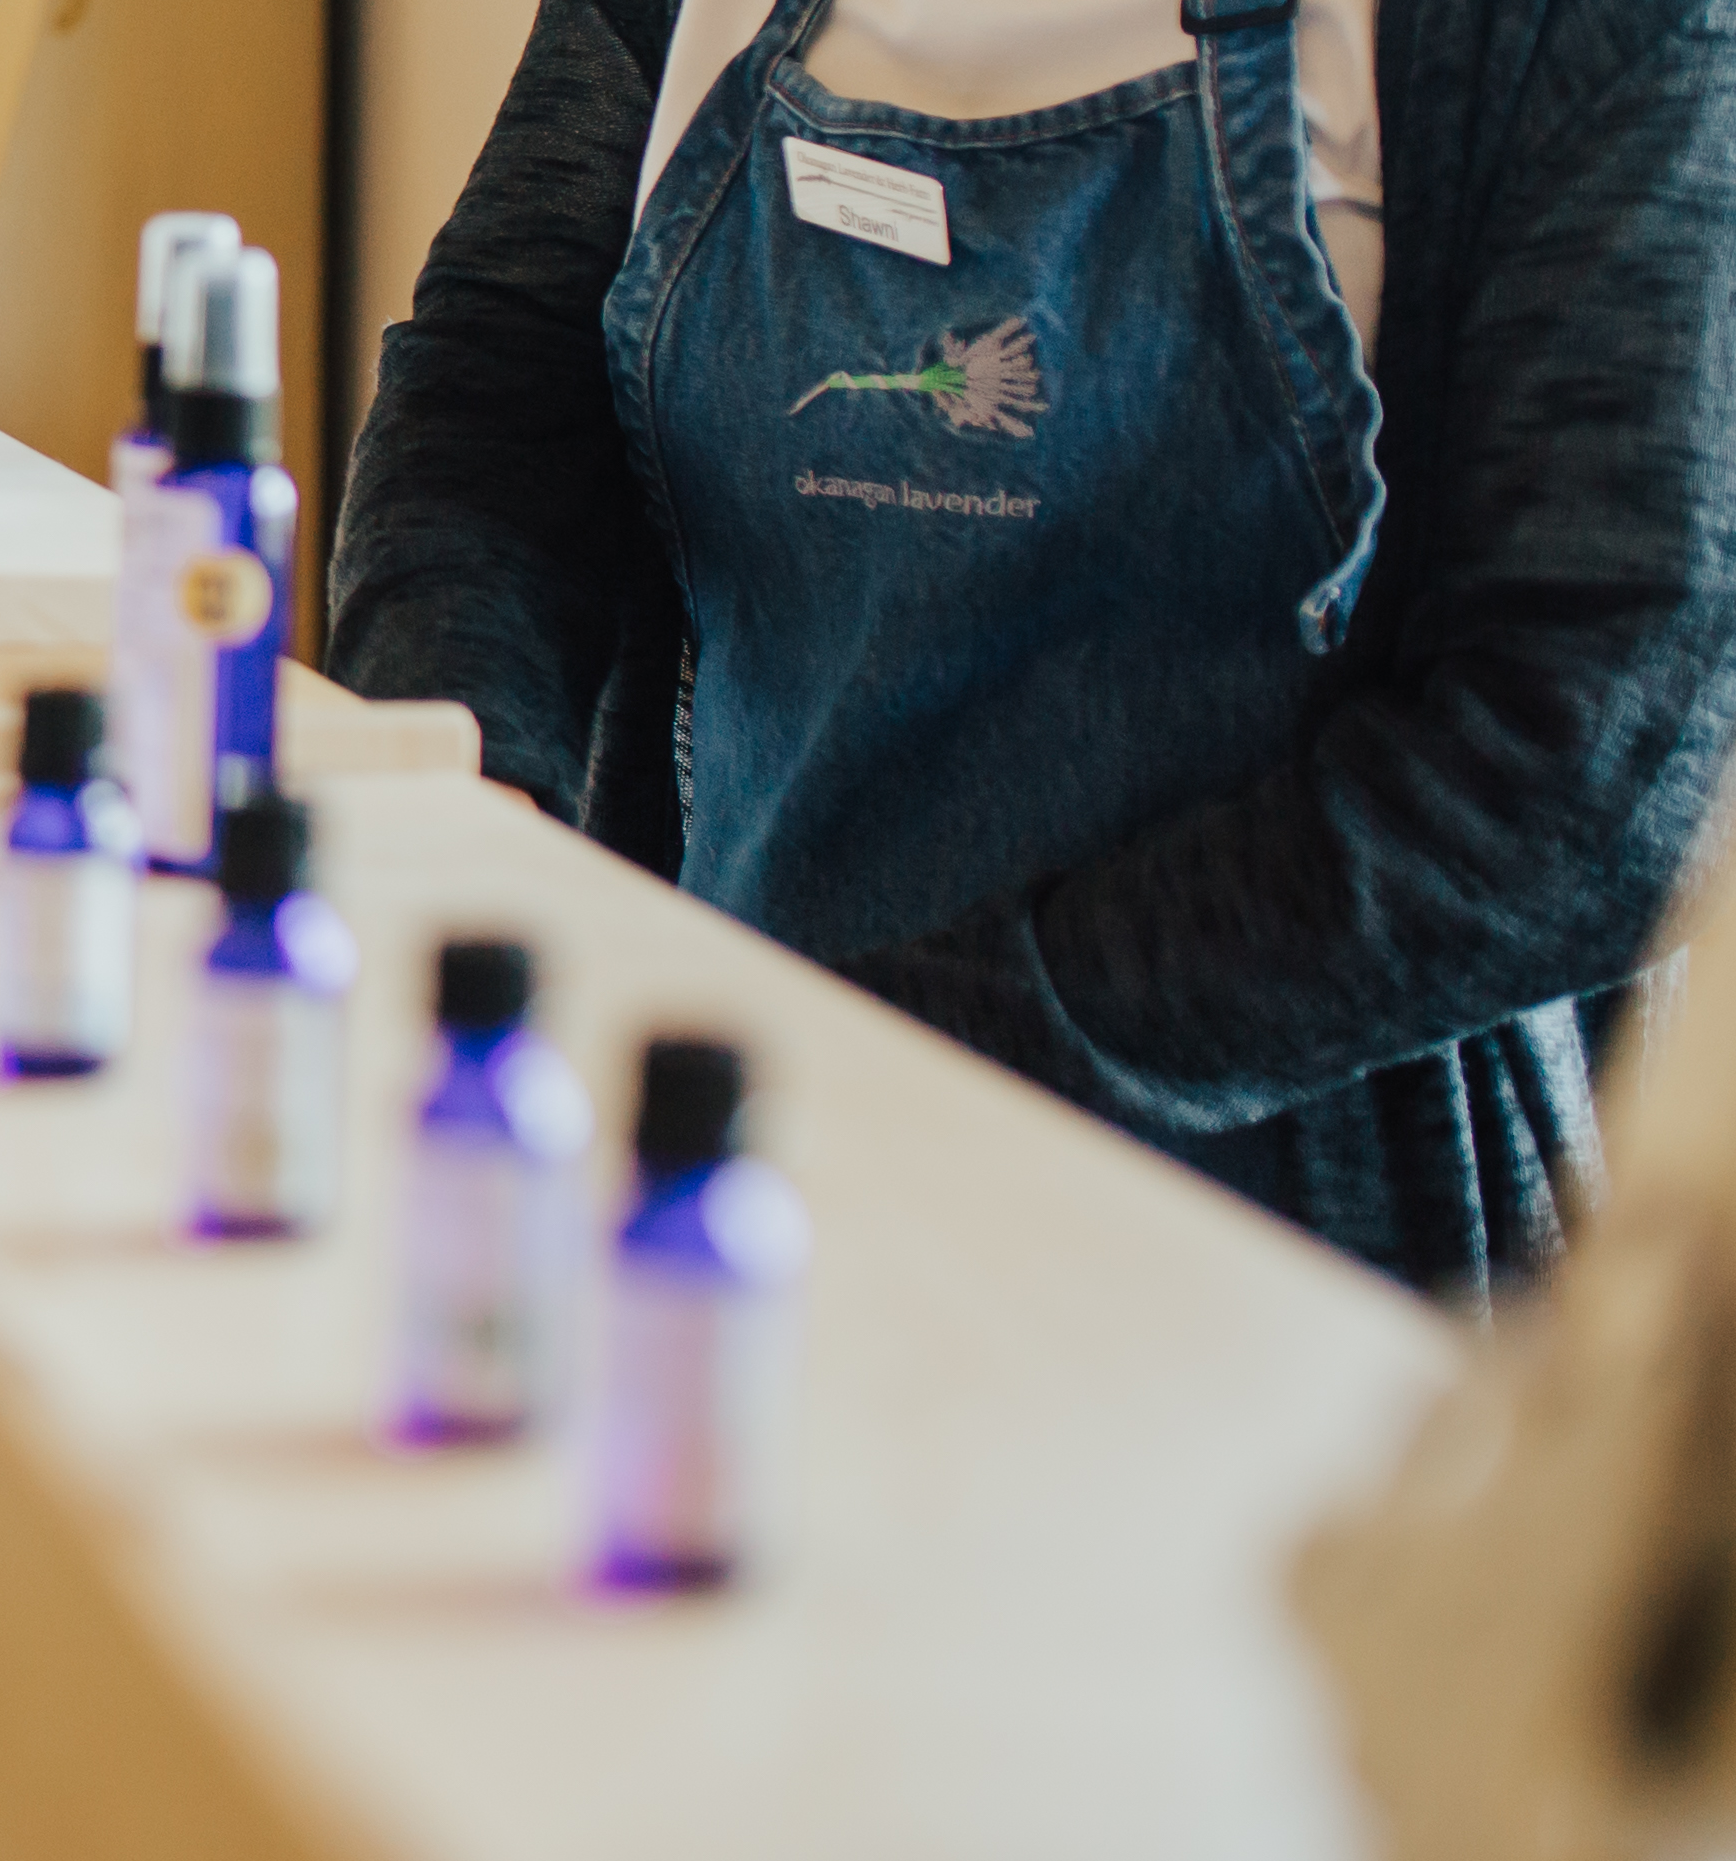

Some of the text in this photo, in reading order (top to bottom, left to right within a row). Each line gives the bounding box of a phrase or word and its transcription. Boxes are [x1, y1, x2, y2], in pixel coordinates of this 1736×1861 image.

[839, 204, 899, 242] Shawni
[794, 469, 1042, 519] okanagan lavender
